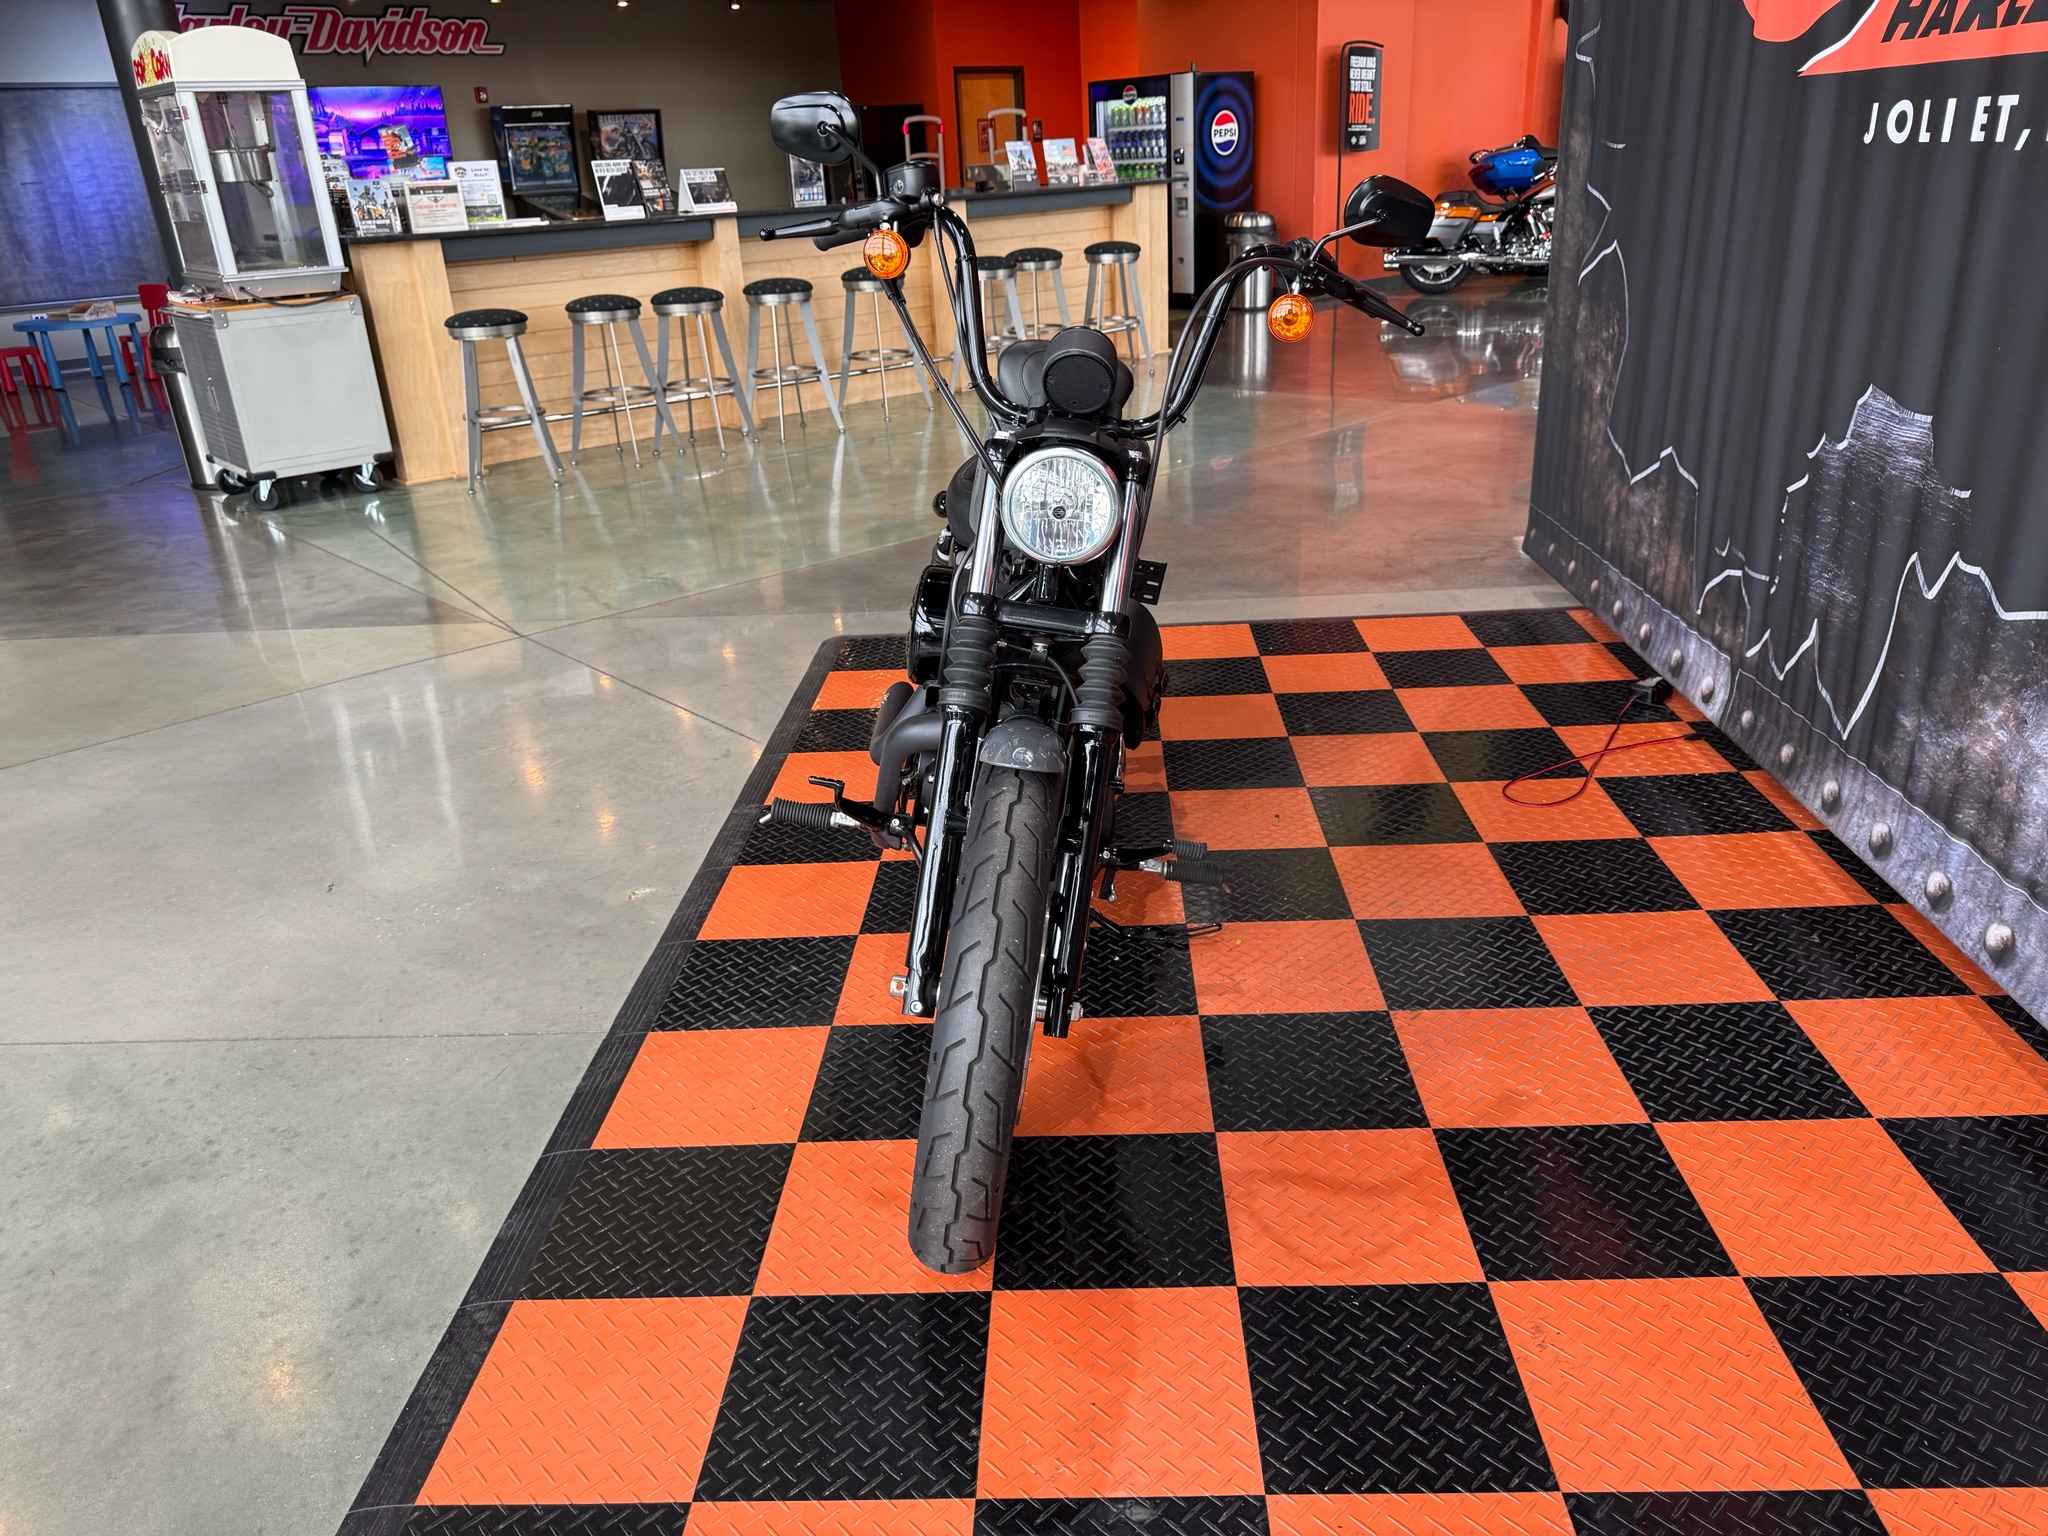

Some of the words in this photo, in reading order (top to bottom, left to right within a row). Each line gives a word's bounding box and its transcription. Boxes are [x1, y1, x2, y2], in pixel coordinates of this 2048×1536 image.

[176, 5, 504, 61] y-Davidson
[1348, 93, 1375, 124] RIDE.
[1213, 128, 1237, 137] PEPSI
